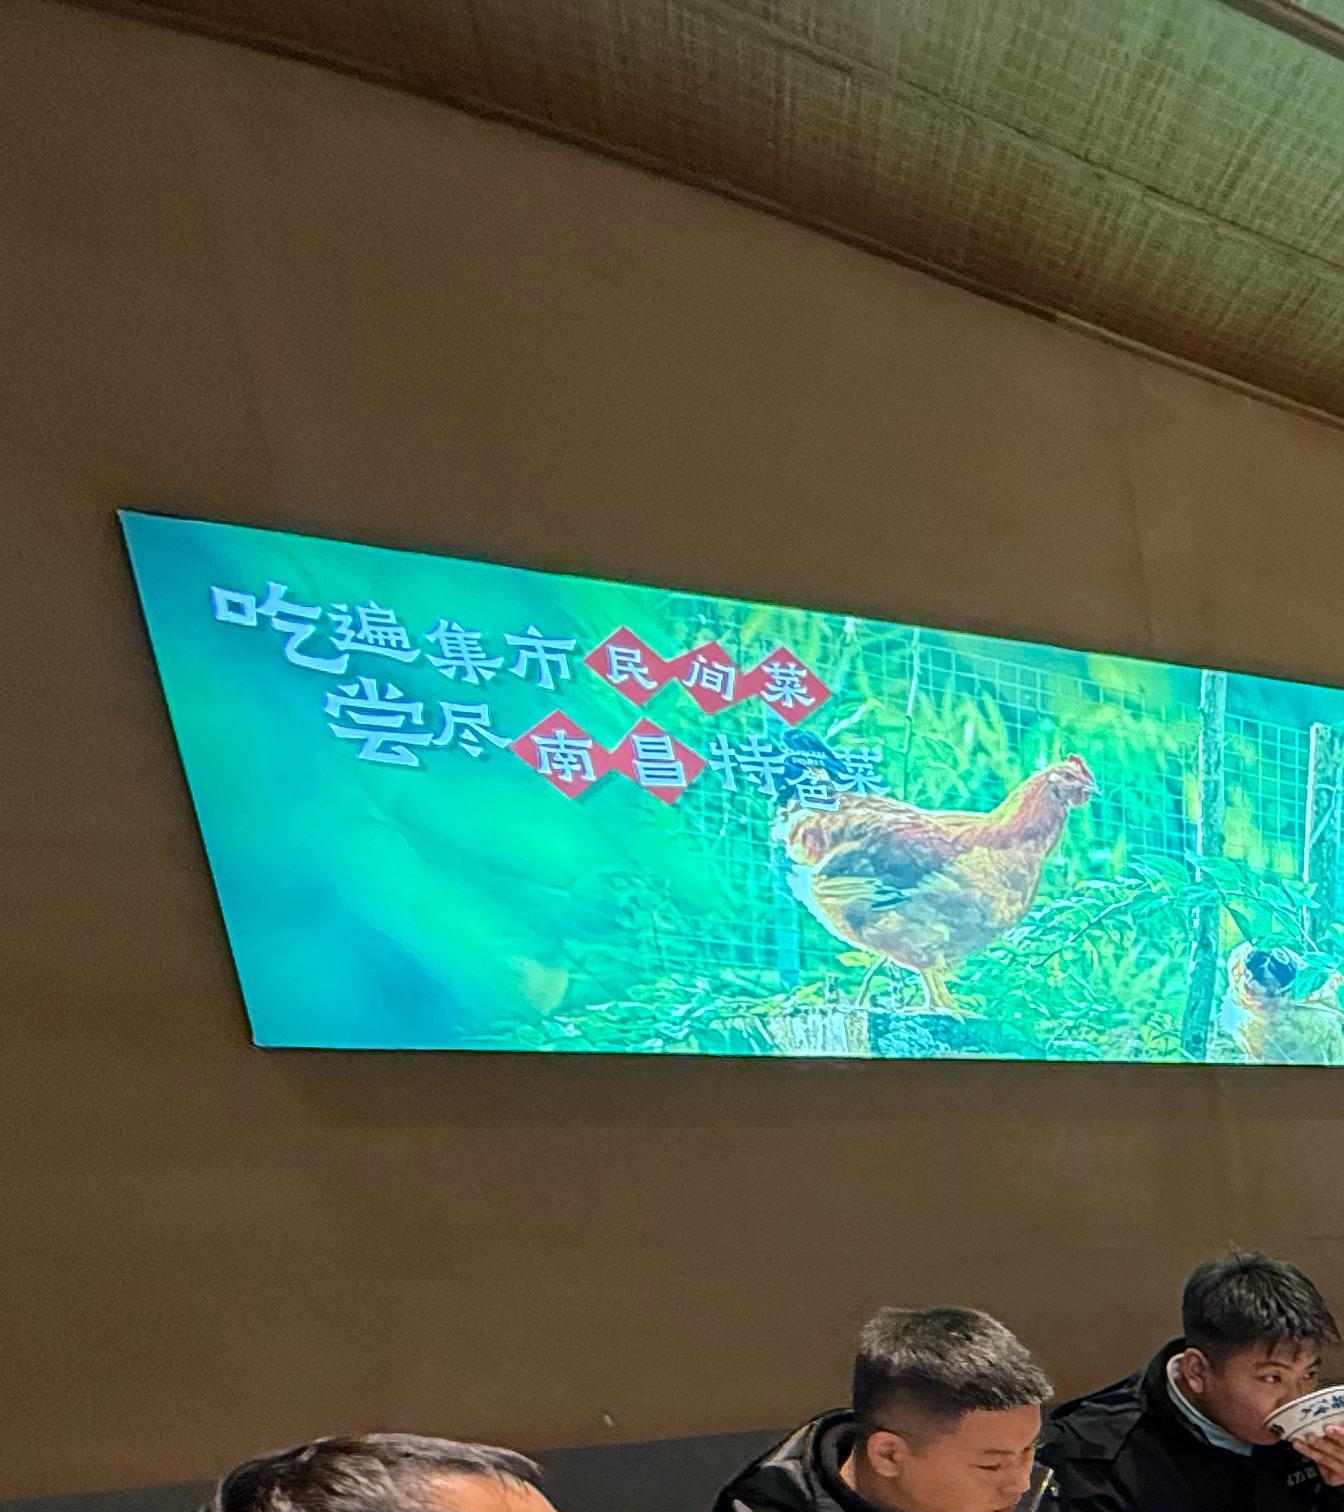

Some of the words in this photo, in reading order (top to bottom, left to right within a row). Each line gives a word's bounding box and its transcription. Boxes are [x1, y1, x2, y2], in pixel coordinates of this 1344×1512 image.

[211, 581, 813, 706] 吃遍集市民间菜
[322, 677, 889, 813] 尝尽南昌特色菜
